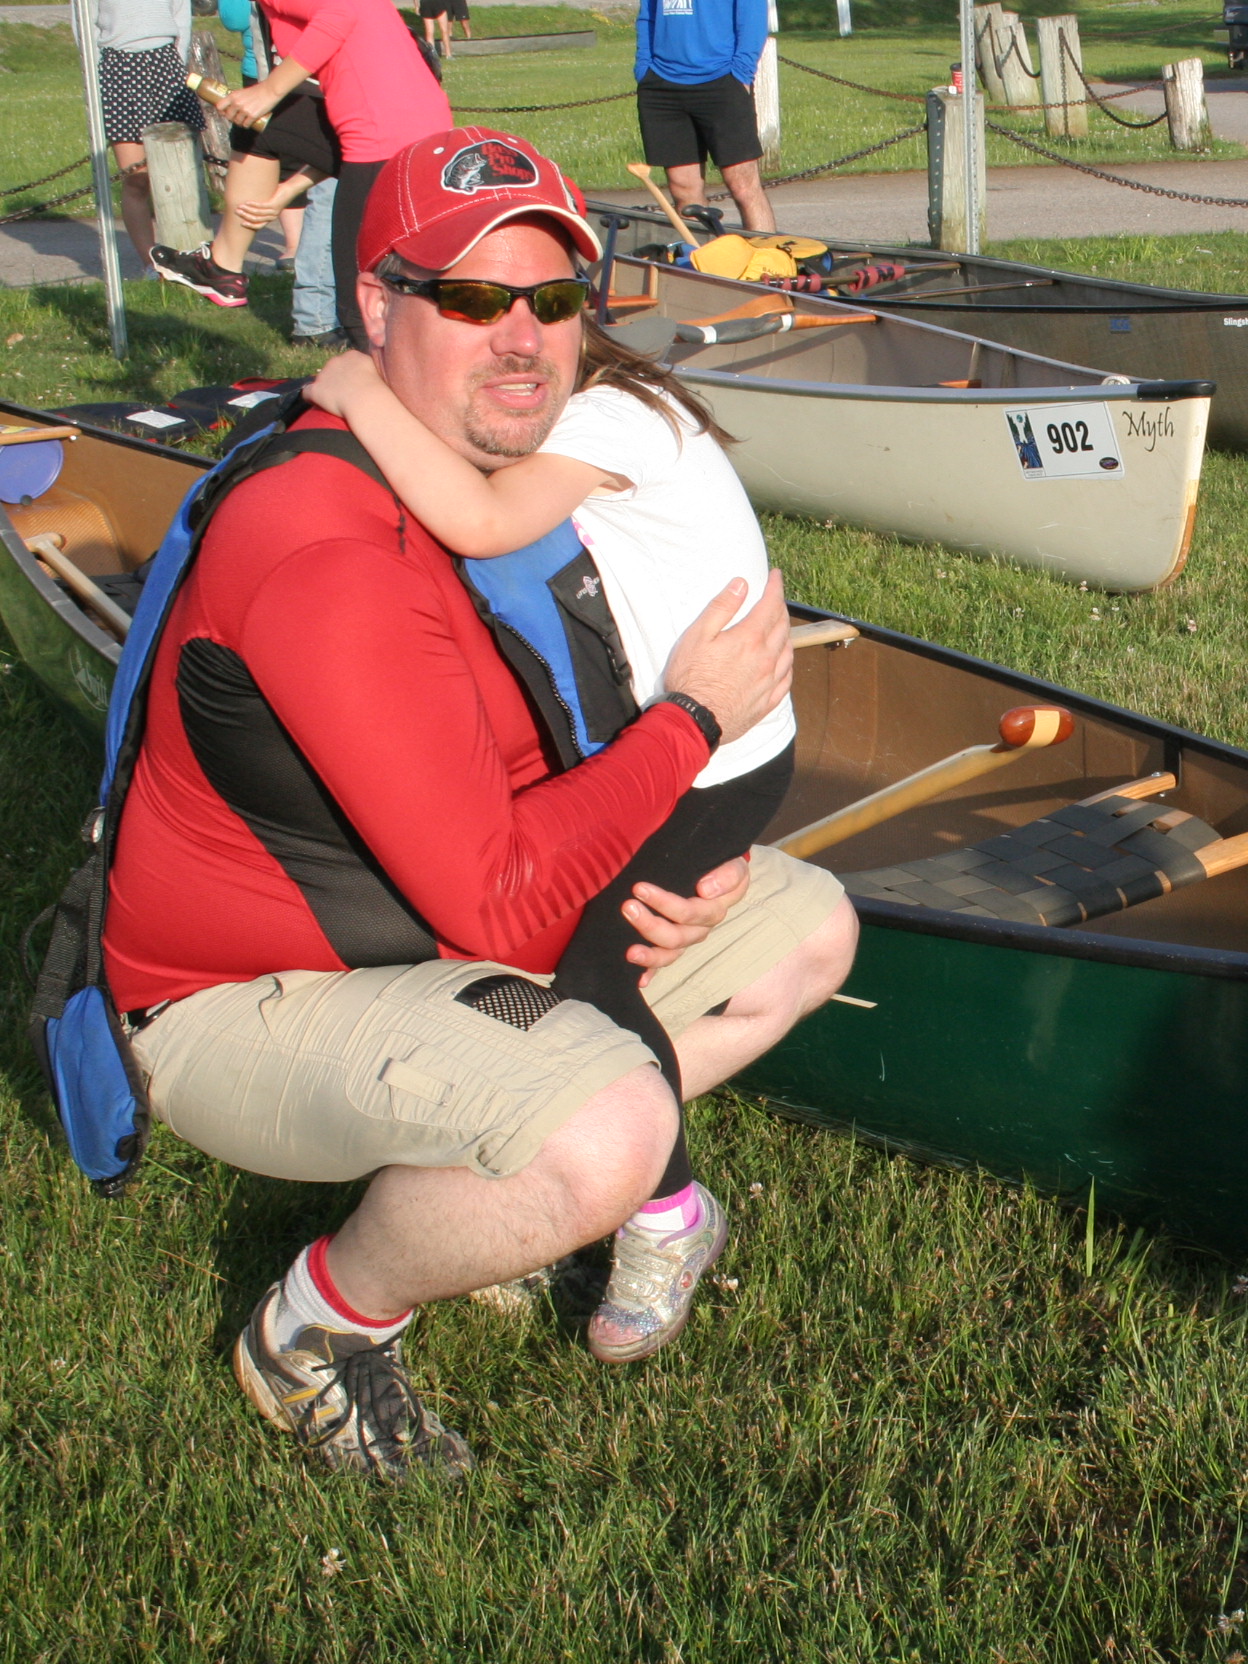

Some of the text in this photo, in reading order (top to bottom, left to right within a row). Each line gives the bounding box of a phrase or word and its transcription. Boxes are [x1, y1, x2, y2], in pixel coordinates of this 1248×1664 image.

[488, 153, 516, 168] Pro
[1047, 420, 1094, 454] 902
[1122, 406, 1174, 452] Myth
